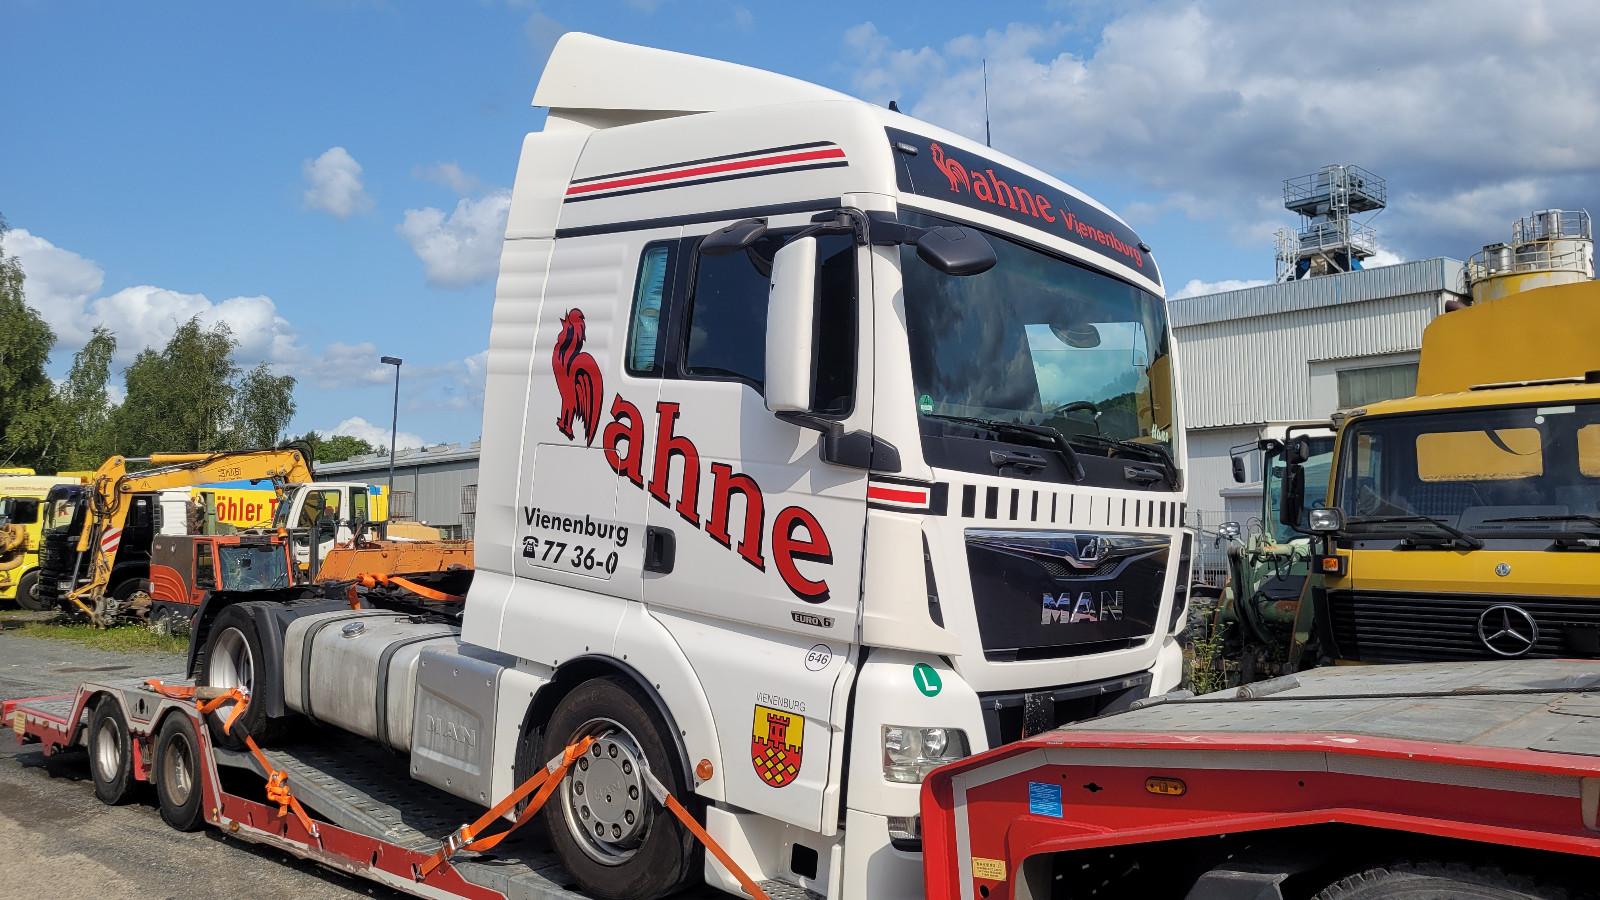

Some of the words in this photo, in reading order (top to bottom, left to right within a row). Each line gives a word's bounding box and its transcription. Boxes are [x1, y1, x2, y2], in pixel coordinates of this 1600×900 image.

[1059, 208, 1143, 268] Vienenburg
[216, 495, 263, 522] öhler
[524, 506, 629, 547] Vienenburg
[541, 540, 568, 563] 77
[570, 545, 619, 575] 36-0
[794, 613, 819, 625] EURO
[823, 617, 831, 627] 6
[1040, 590, 1125, 625] MAN
[807, 652, 829, 665] 646
[917, 666, 938, 692] L
[756, 691, 806, 712] VIENENBURG
[425, 714, 477, 749] MAN
